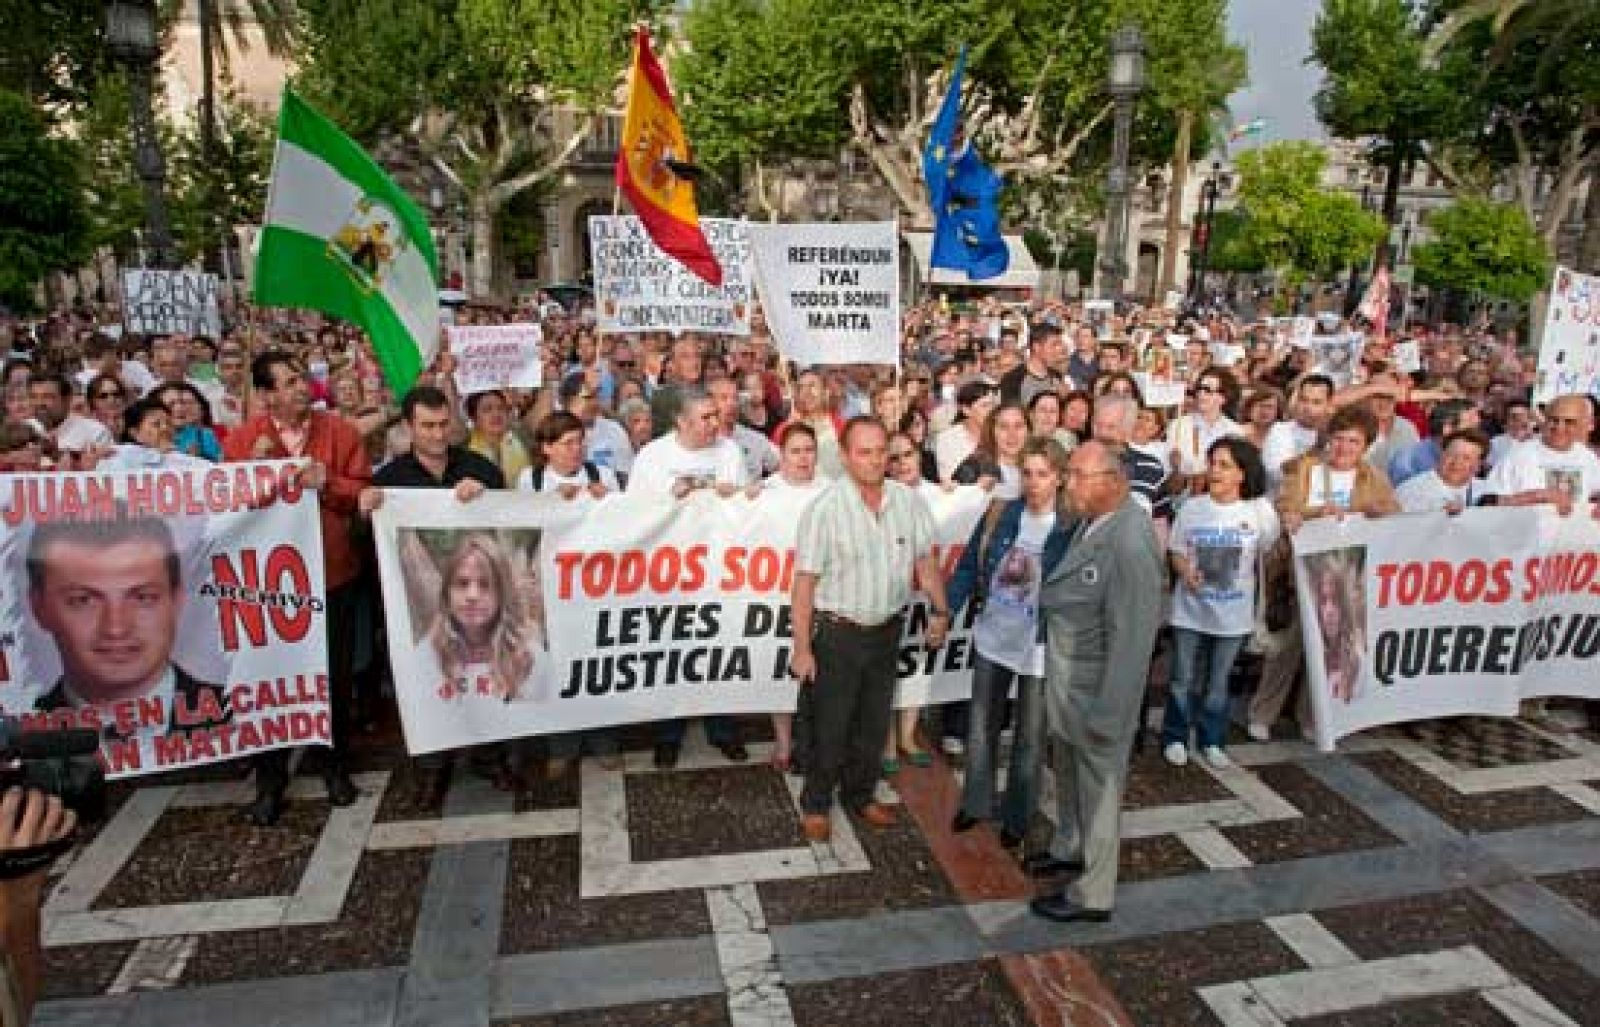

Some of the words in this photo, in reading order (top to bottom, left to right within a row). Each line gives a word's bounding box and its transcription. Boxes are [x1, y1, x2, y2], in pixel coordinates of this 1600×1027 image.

[790, 291, 838, 309] TODOS
[843, 291, 891, 309] SOMOS
[808, 312, 870, 331] MARTA
[5, 477, 116, 526] JUAN
[127, 464, 301, 516] HOLGADO
[200, 584, 324, 611] ARCHIVO
[211, 544, 311, 652] NO
[554, 545, 710, 600] TODOS
[1376, 558, 1514, 608] TODOS
[596, 604, 723, 648] LEYES
[559, 645, 751, 699] JUSTICIA
[21, 704, 101, 732] MOS
[113, 699, 164, 737] EN
[174, 687, 222, 726] LA
[231, 674, 330, 713] CALLE
